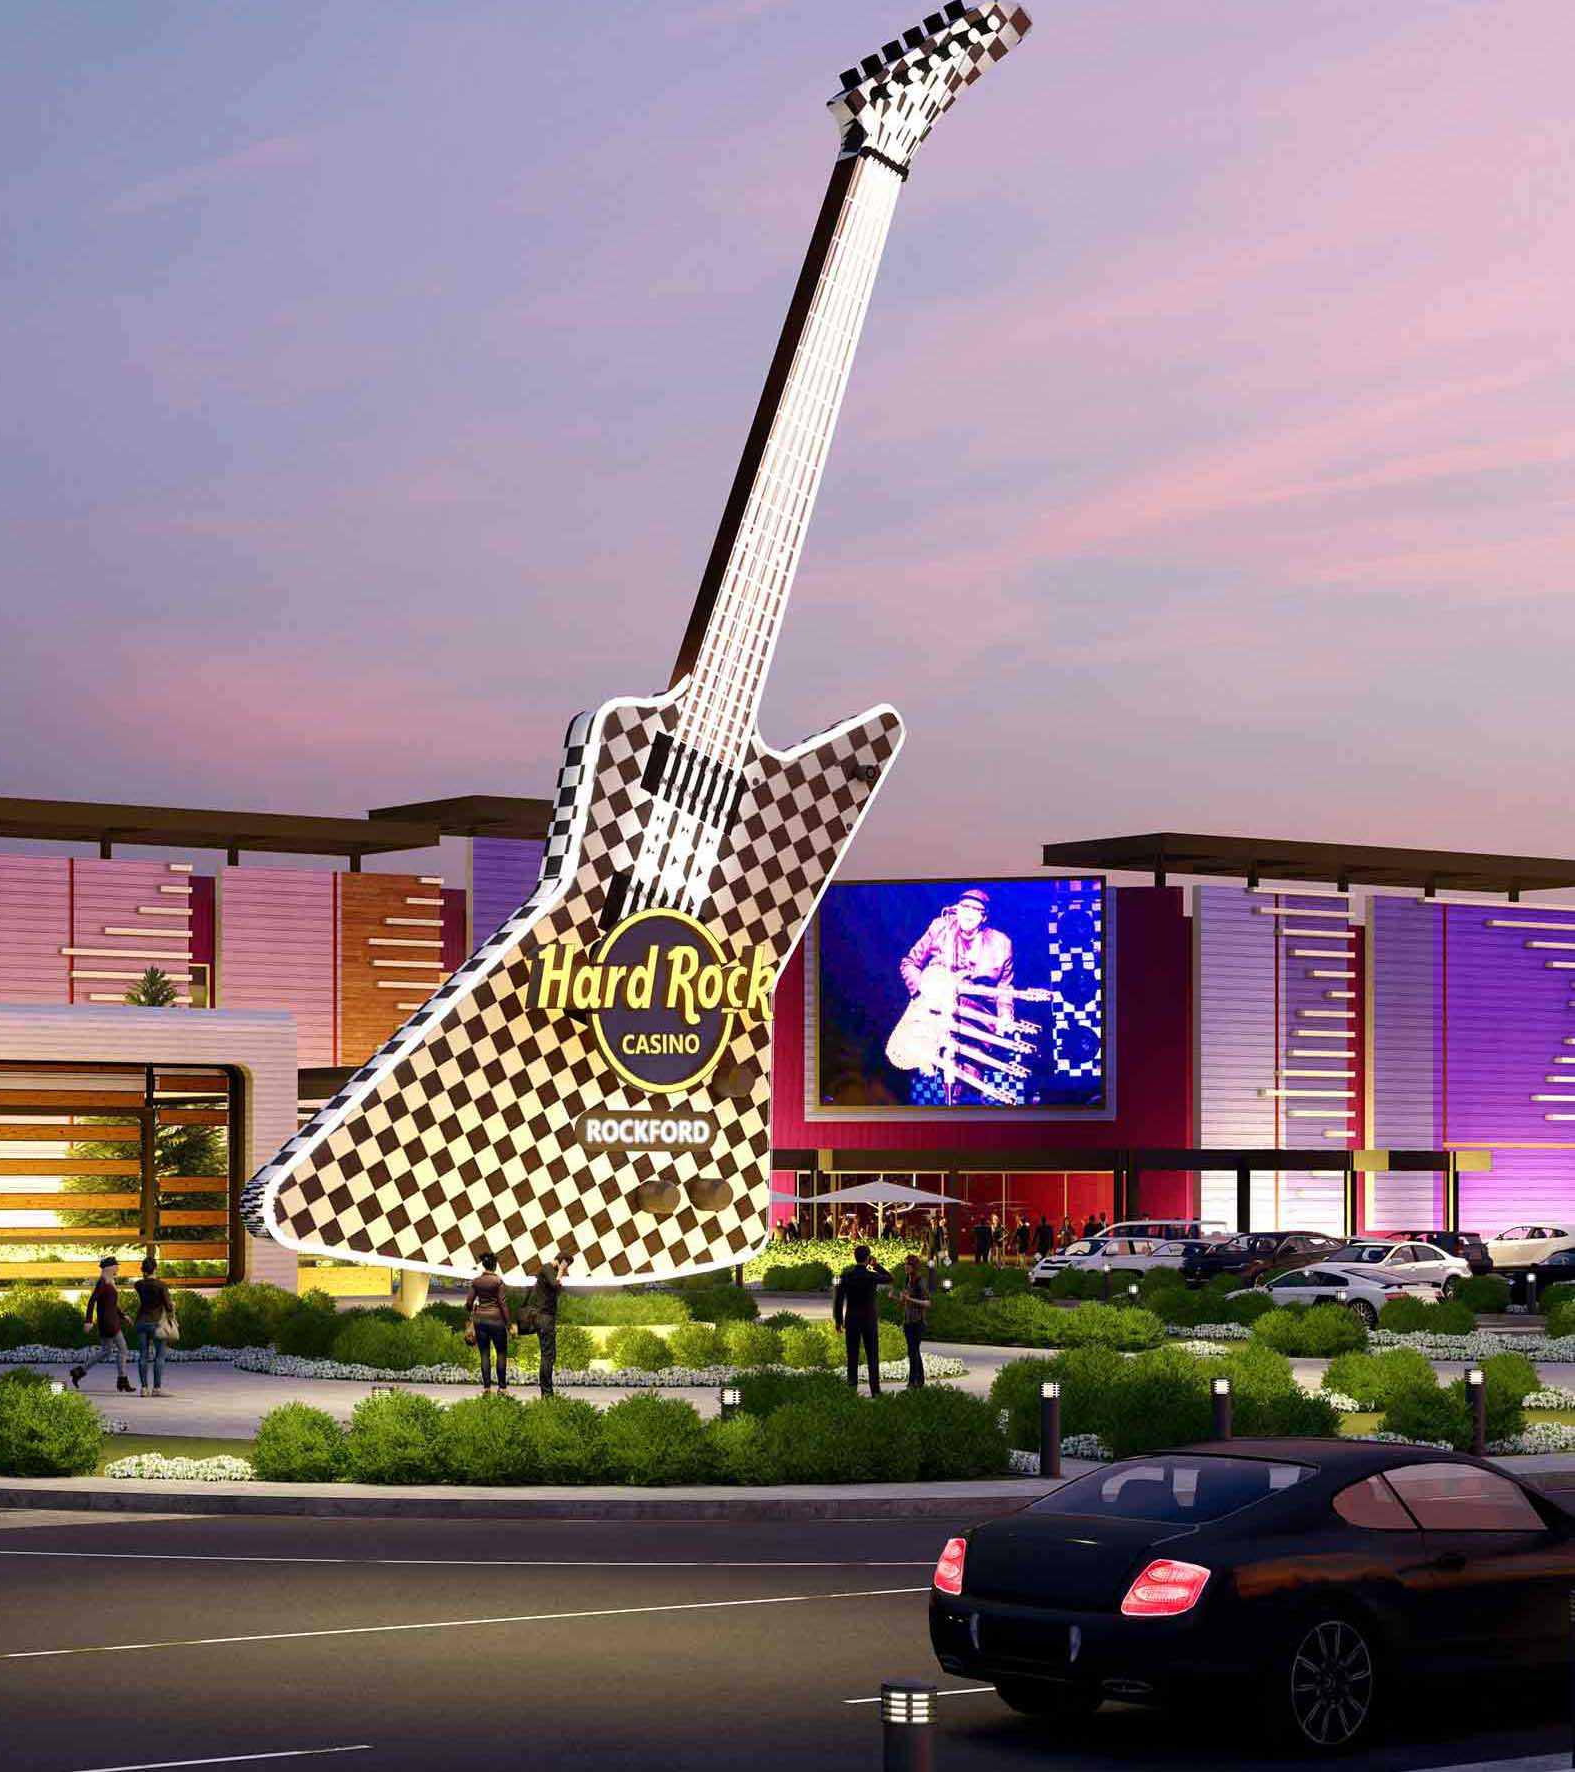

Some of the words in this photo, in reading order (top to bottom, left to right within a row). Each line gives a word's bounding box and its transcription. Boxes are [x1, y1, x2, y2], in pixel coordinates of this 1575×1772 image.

[536, 943, 660, 1009] Hard
[666, 944, 777, 1026] Rock
[621, 1033, 701, 1056] CASINO
[585, 1117, 712, 1145] ROCKFORD
